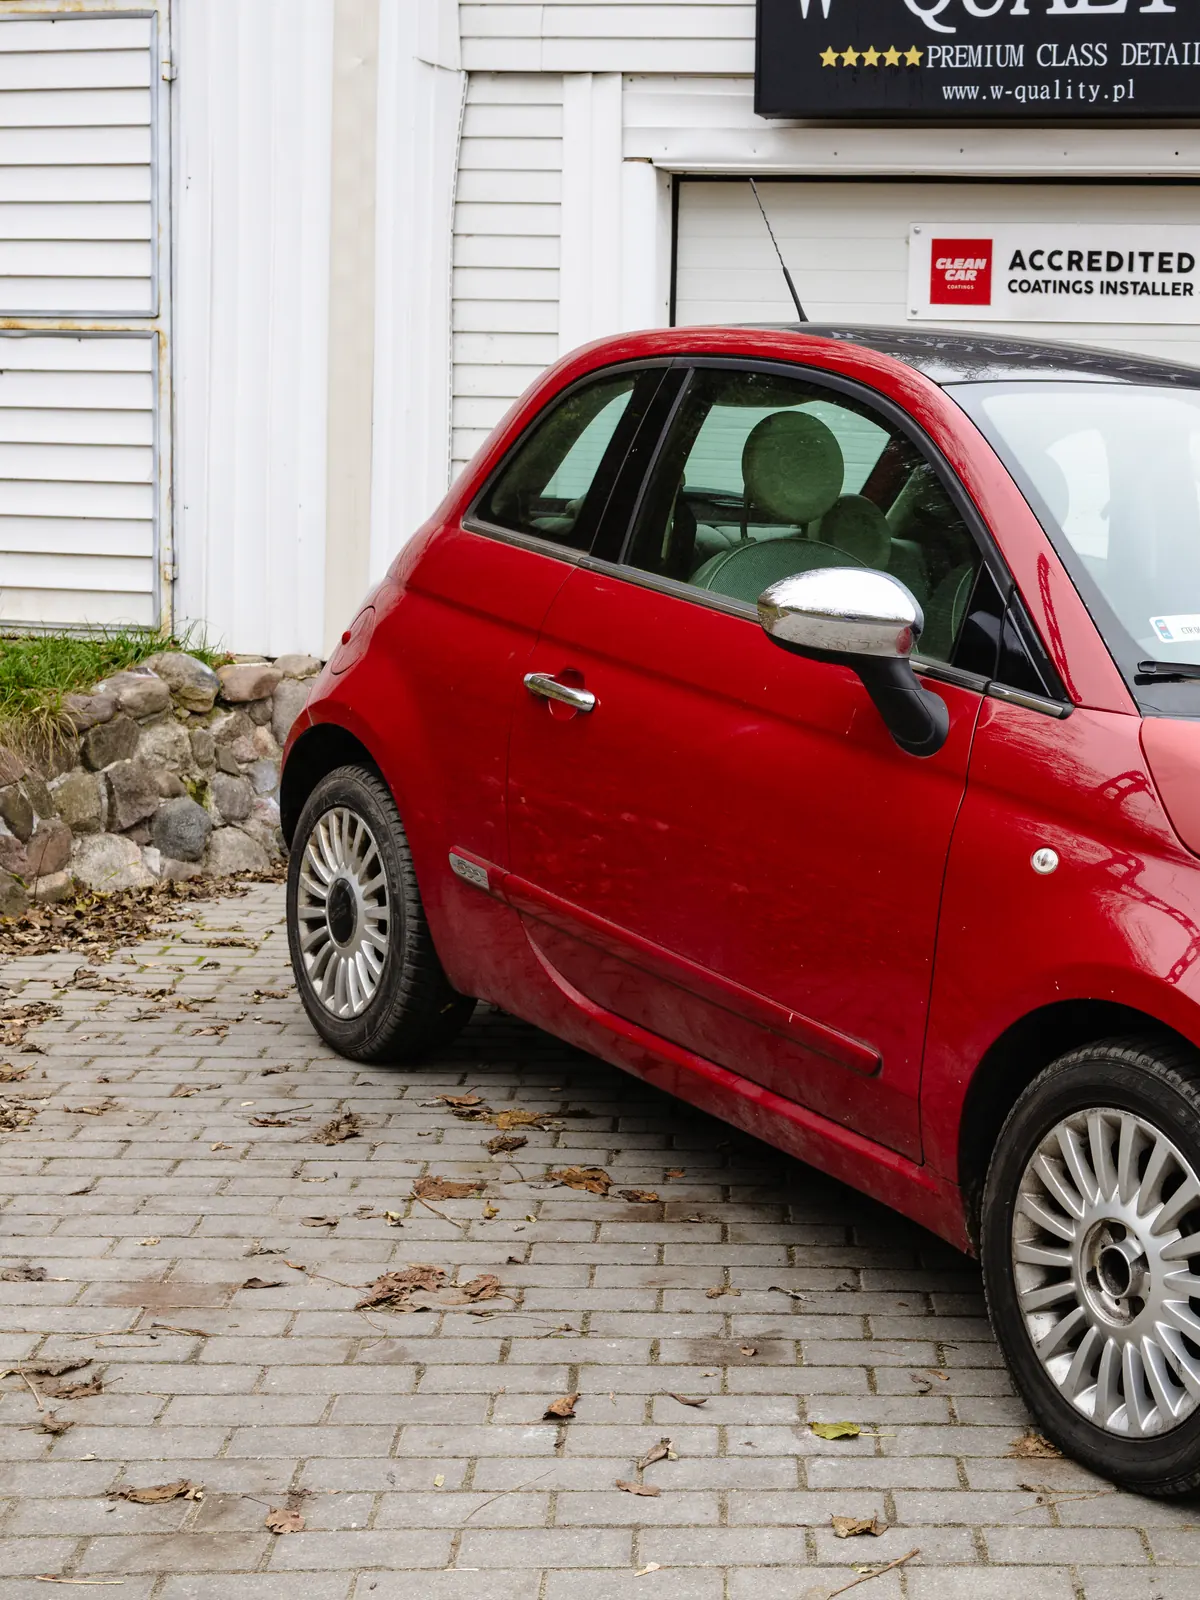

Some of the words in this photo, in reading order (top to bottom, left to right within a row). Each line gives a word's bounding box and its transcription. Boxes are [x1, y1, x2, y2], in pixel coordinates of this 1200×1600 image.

[926, 45, 1024, 68] PREMIUM
[1036, 43, 1108, 67] CLASS
[942, 79, 1135, 102] www.w-quality.pl
[935, 258, 987, 271] CLEAN
[1008, 249, 1196, 274] ACCREDITED
[944, 269, 978, 281] CAR
[1007, 279, 1094, 295] COATINGS
[1100, 280, 1194, 297] INSTALLER
